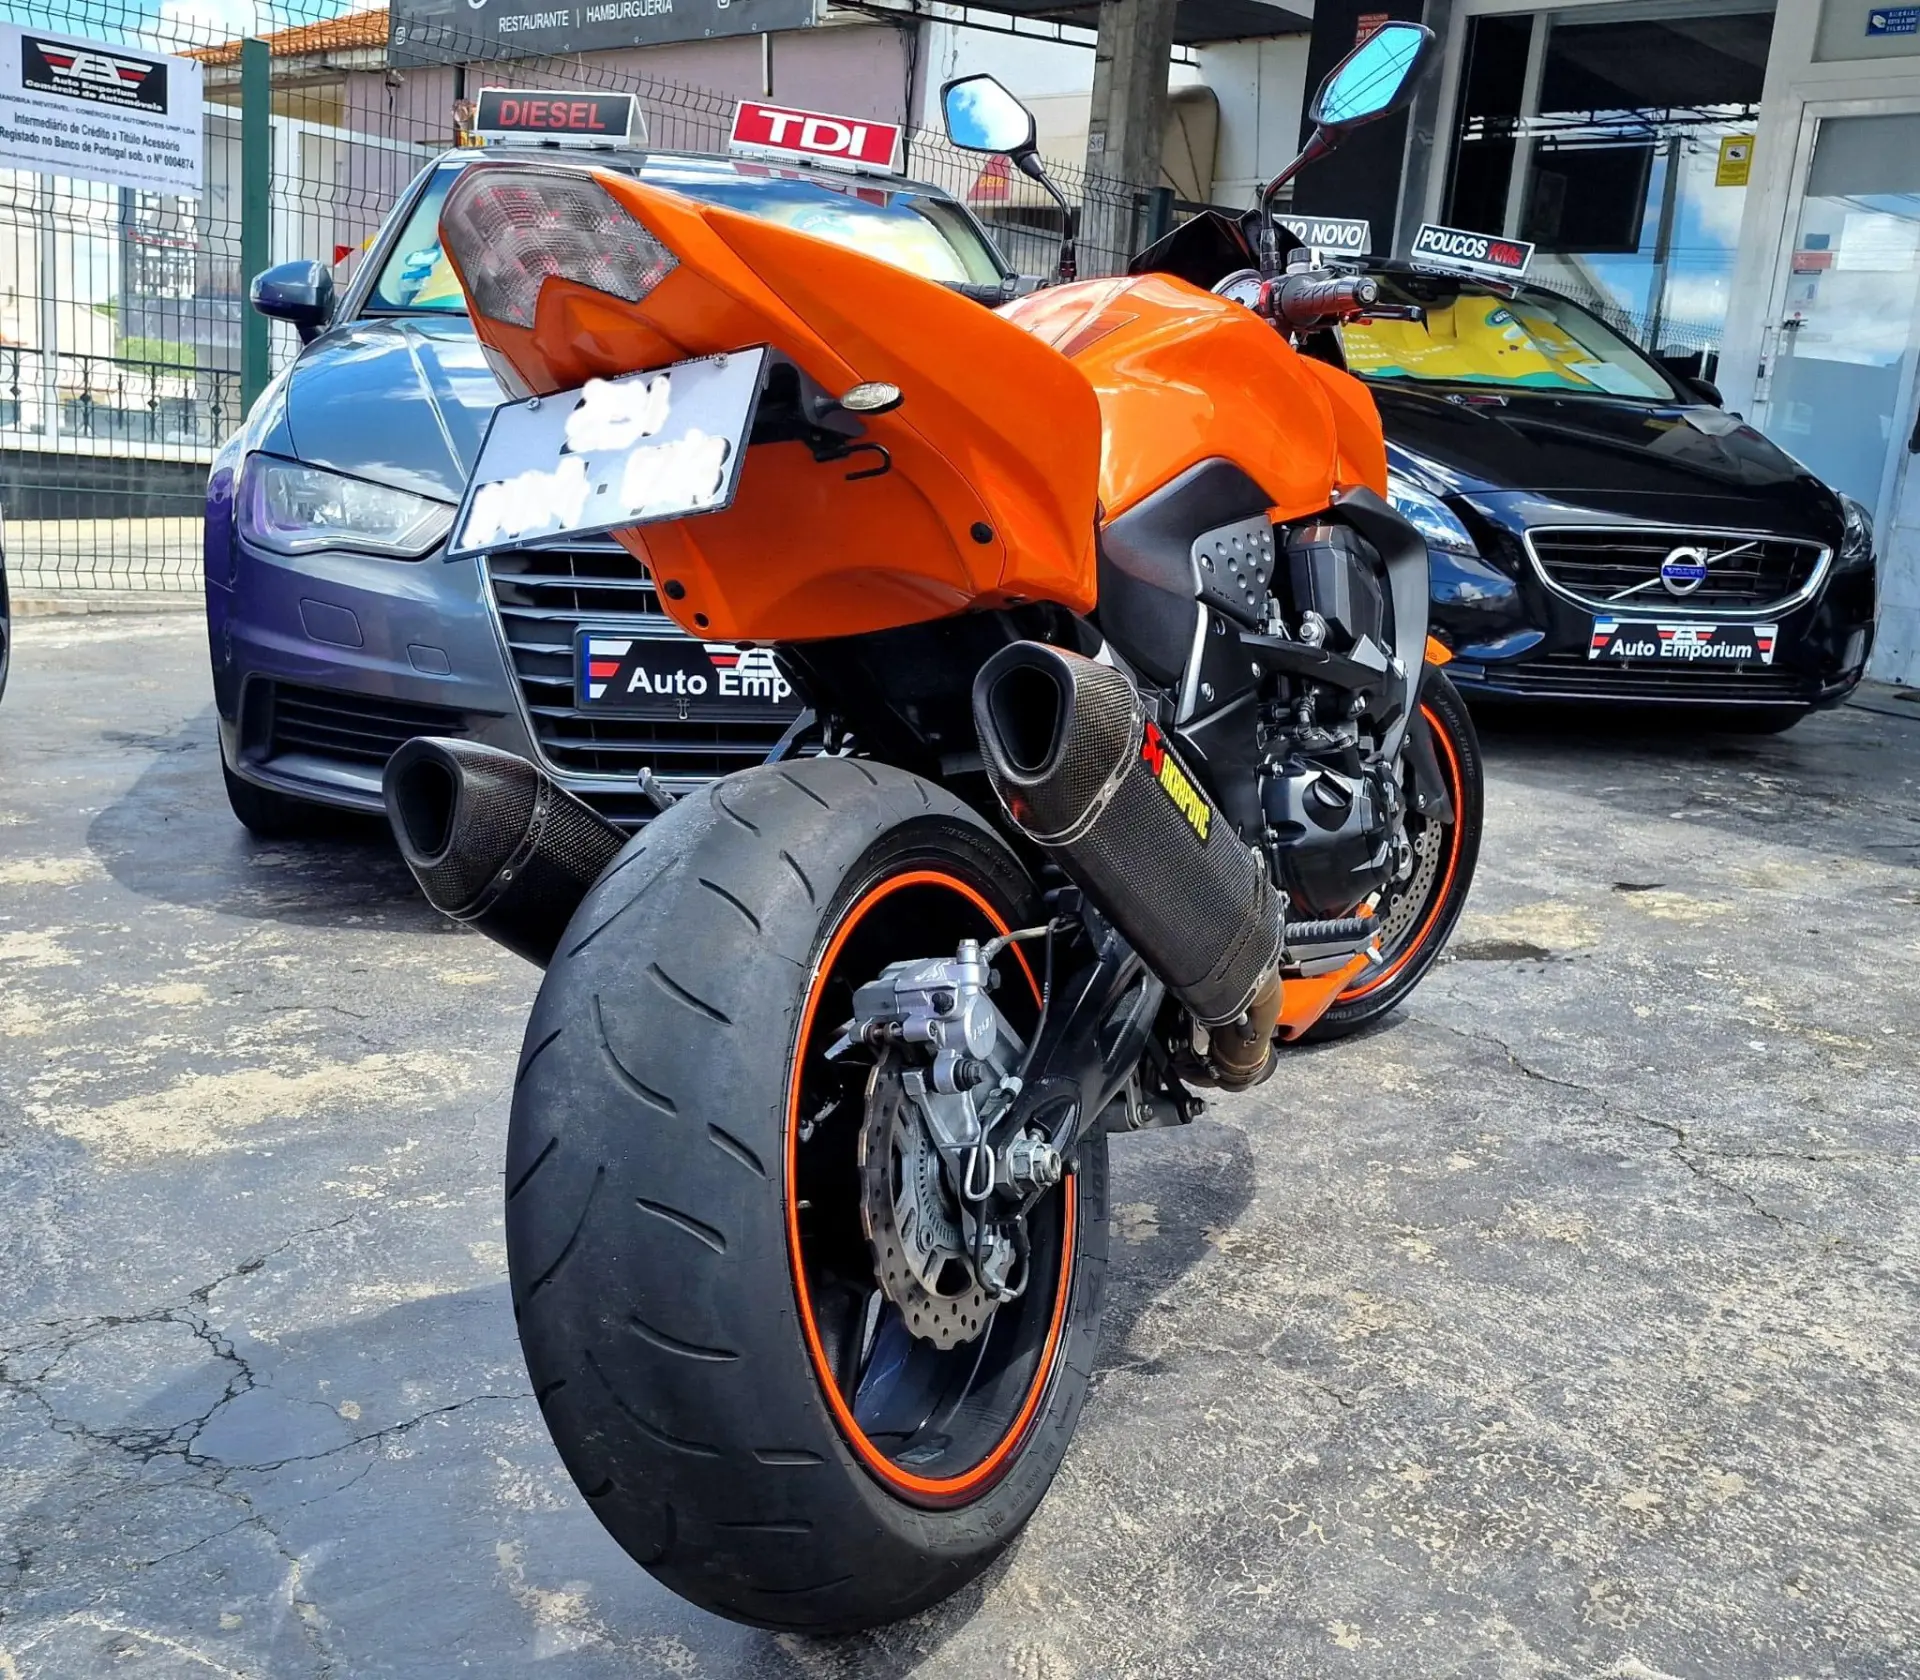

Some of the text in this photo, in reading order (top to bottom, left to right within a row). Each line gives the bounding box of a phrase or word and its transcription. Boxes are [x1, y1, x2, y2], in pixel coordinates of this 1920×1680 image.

[499, 9, 570, 33] RESTAURANTE
[25, 79, 80, 96] Comércio
[82, 88, 97, 100] de
[52, 76, 138, 99] Auto Emporium
[499, 98, 606, 130] DIESEL
[0, 126, 40, 143] Registado
[42, 135, 53, 146] no
[54, 136, 80, 151] Banco
[82, 141, 92, 153] de
[94, 142, 127, 160] Portugal
[14, 111, 68, 133] Intermediário
[70, 122, 80, 134] de
[81, 124, 110, 140] Crédito
[112, 132, 117, 141] a
[142, 134, 180, 152] Acessório
[758, 110, 867, 157] TDI
[1311, 223, 1362, 246] NOVO
[1419, 229, 1489, 259] POUCOS
[1610, 638, 1753, 662] Auto Emporium
[626, 666, 708, 696] Auto
